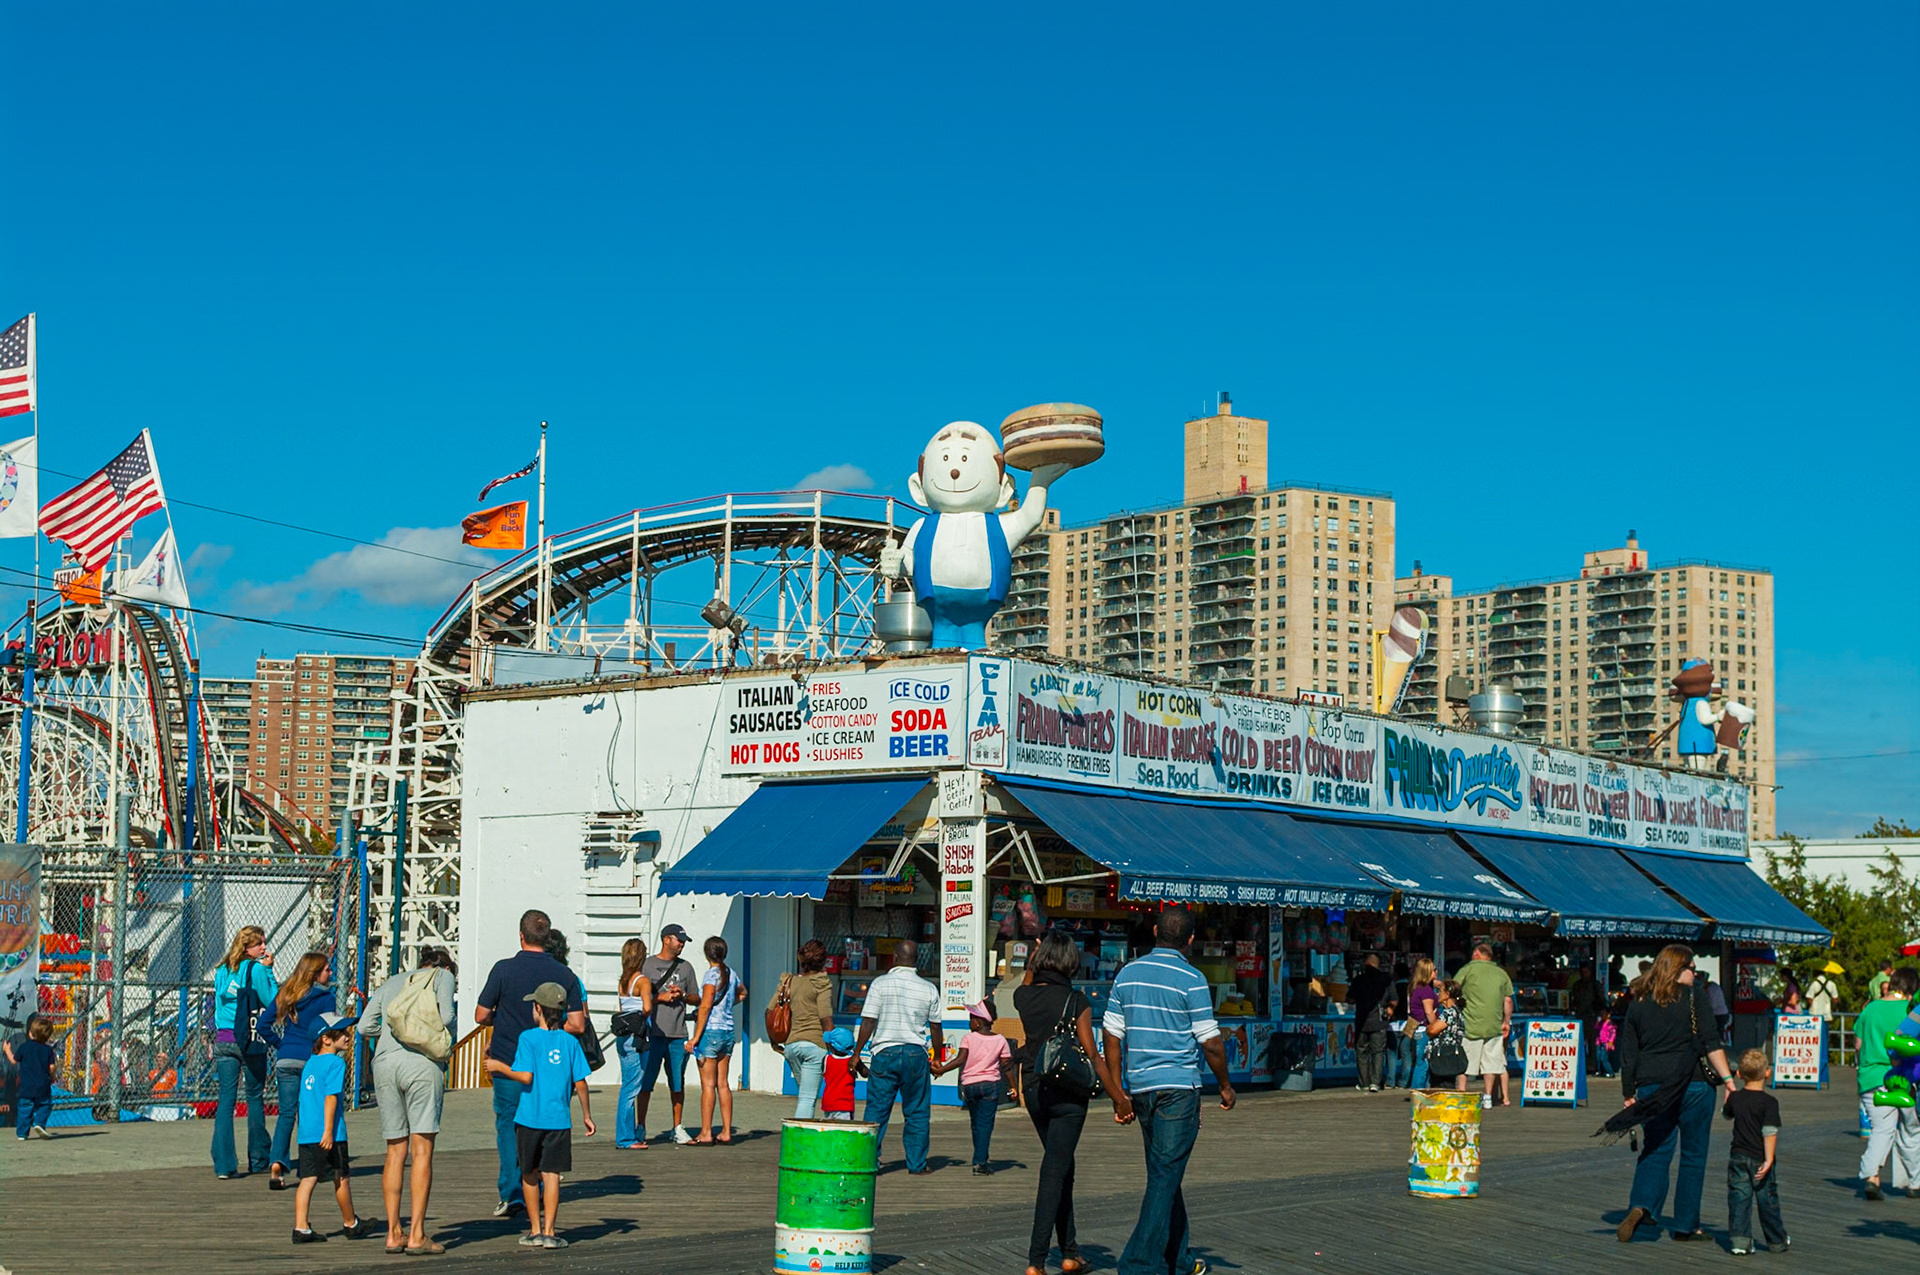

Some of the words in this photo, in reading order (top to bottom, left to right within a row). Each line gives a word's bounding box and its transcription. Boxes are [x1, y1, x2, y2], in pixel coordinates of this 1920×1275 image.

[812, 682, 841, 695] FRIES
[889, 682, 910, 699] ICE
[914, 685, 950, 701] COLD
[1030, 674, 1070, 697] SABRETT
[738, 685, 794, 708] ITALIAN
[979, 663, 1000, 727] CLAM
[1138, 690, 1165, 712] HOT
[1169, 694, 1202, 718] CORN
[811, 697, 867, 712] SEAFOOD
[729, 710, 802, 734] SAUSAGES
[811, 715, 846, 729] COTTON
[849, 713, 878, 727] CANDY
[891, 708, 948, 732] SODA
[1238, 718, 1253, 731] FRIED
[812, 732, 829, 745] ICE
[832, 730, 875, 744] CREAM
[974, 724, 1000, 742] BAR
[1123, 711, 1169, 761] ITALIAN
[1171, 720, 1217, 766] SAUSAGE
[1322, 716, 1341, 744] Pop
[1344, 723, 1365, 743] Corn
[731, 744, 759, 765] HOT
[763, 742, 800, 762] DOGS
[812, 747, 863, 762] SLUSHIES
[889, 735, 949, 758] BEER
[1222, 726, 1258, 769] COLD
[1264, 735, 1301, 774] BEER
[1016, 747, 1063, 768] HAMBURGERS
[1066, 753, 1091, 771] FRENCH
[1092, 757, 1111, 773] FRIES
[1305, 736, 1343, 781] COTTON
[1345, 749, 1375, 784] CANDY
[1137, 762, 1164, 787] Sea
[1167, 764, 1199, 789] Food
[1385, 727, 1449, 813] PAUL'S
[1443, 744, 1522, 816] Daughter
[944, 773, 965, 793] HEY!
[1227, 771, 1292, 799] DRINKS
[1312, 781, 1332, 803] ICE
[1335, 784, 1369, 808] CREAM
[1530, 774, 1549, 808] HOT
[1551, 782, 1580, 812] PIZZA
[1583, 783, 1606, 816] COLD
[1607, 790, 1630, 821] BEER
[1635, 787, 1667, 825] ITALIAN
[1669, 796, 1698, 828] SAUSAGE
[948, 829, 970, 842] BROIL
[1589, 818, 1627, 841] DRINKS
[1645, 826, 1663, 842] SEA
[1666, 829, 1690, 845] FOOD
[945, 845, 974, 860] SHISH
[945, 860, 974, 875] Kabob
[946, 893, 971, 902] ITALIAN
[1130, 881, 1144, 895] ALL
[1146, 882, 1164, 896] BEEF
[1165, 883, 1191, 897] FRANKS
[1199, 885, 1228, 899] BURGERS
[1237, 886, 1255, 900] SHISH
[1256, 887, 1276, 900] KEBOB
[1284, 889, 1298, 902] HOT
[1299, 890, 1319, 903] ITALIAN
[946, 904, 972, 920] SAUSAGE
[1449, 901, 1459, 913] POP
[1460, 902, 1475, 914] CORN
[1478, 903, 1498, 916] COTTON
[945, 945, 970, 954] SPECIAL
[945, 956, 970, 964] Chicken
[945, 964, 971, 973] Tenders
[1739, 965, 1752, 997] ATM
[947, 996, 966, 1005] FRIES
[1554, 1032, 1573, 1040] CAKE
[1778, 1036, 1819, 1046] ITALIAN
[1528, 1044, 1577, 1056] ITALIAN
[1783, 1048, 1813, 1058] ICES
[1534, 1060, 1569, 1071] ICES
[1525, 1080, 1540, 1089] ICE
[1544, 1081, 1574, 1091] CREAM
[834, 1261, 850, 1271] HELP
